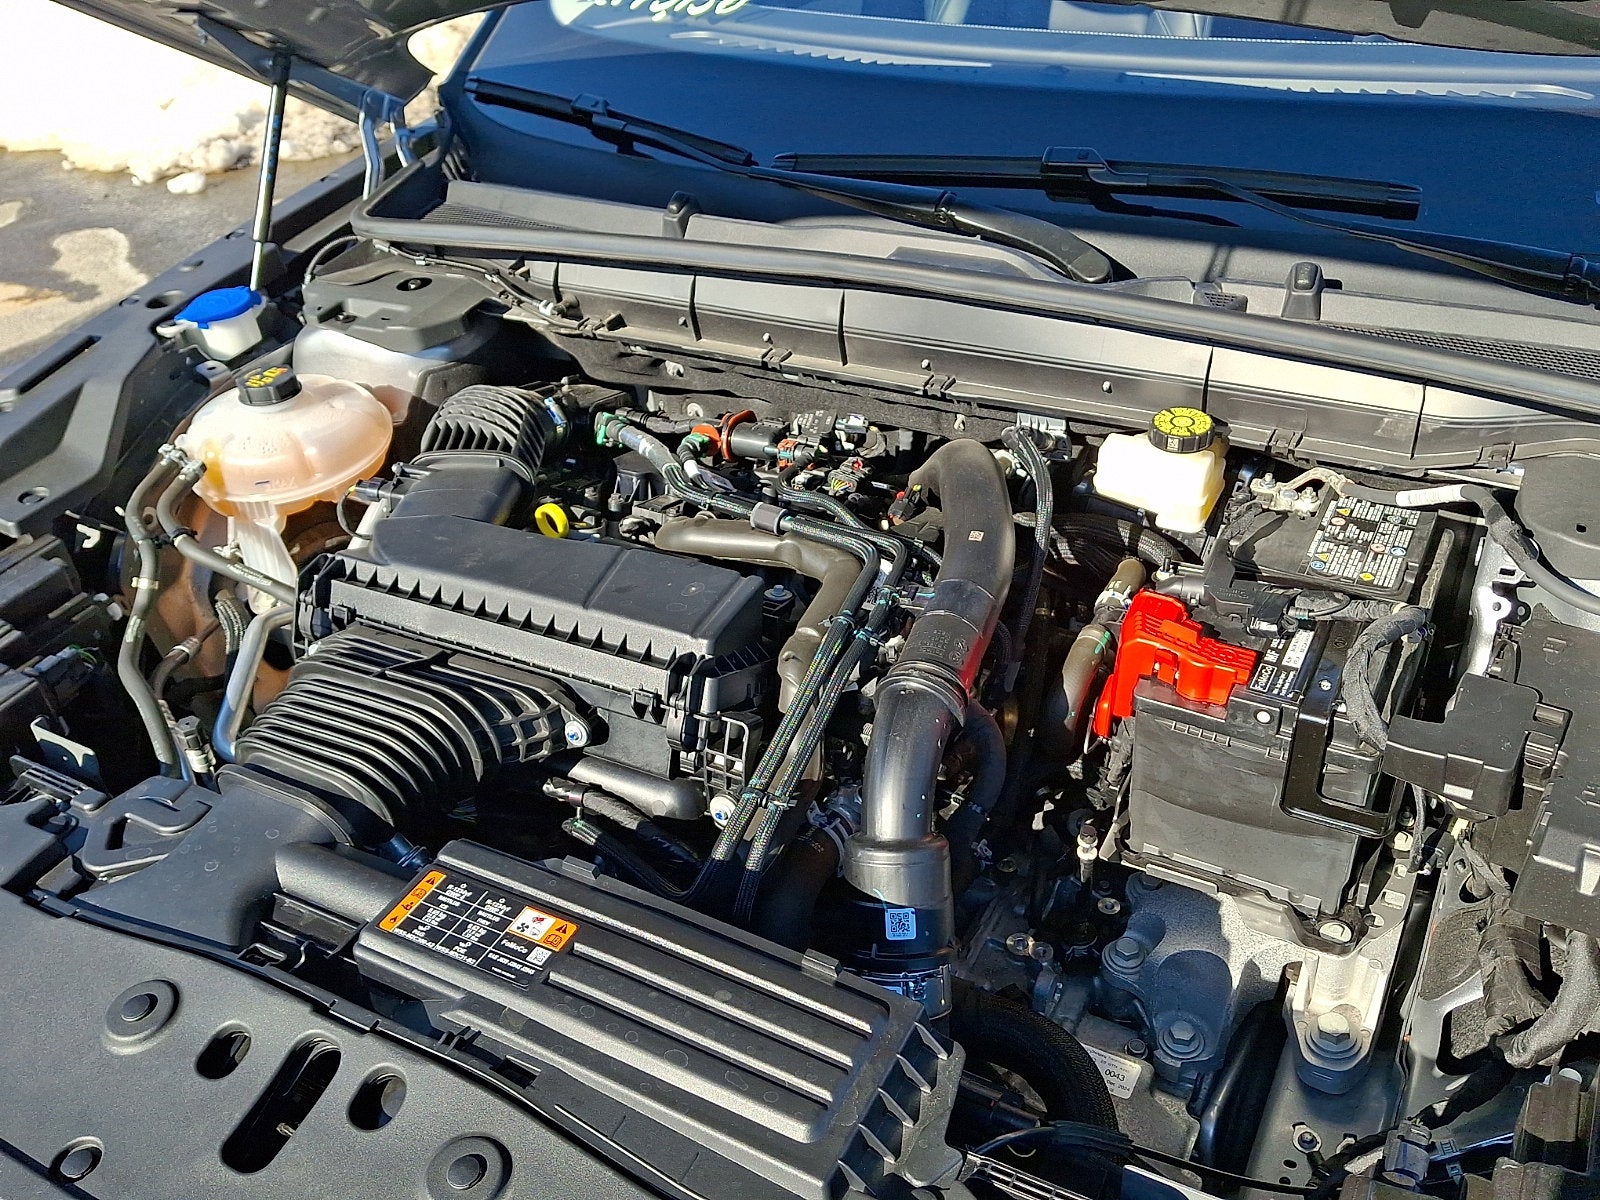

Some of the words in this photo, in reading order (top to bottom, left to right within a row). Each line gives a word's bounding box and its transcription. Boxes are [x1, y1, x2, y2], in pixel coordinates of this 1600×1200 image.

[1254, 666, 1273, 691] FoMoCo
[499, 938, 529, 953] FoMoCo
[1104, 1069, 1126, 1082] 0043
